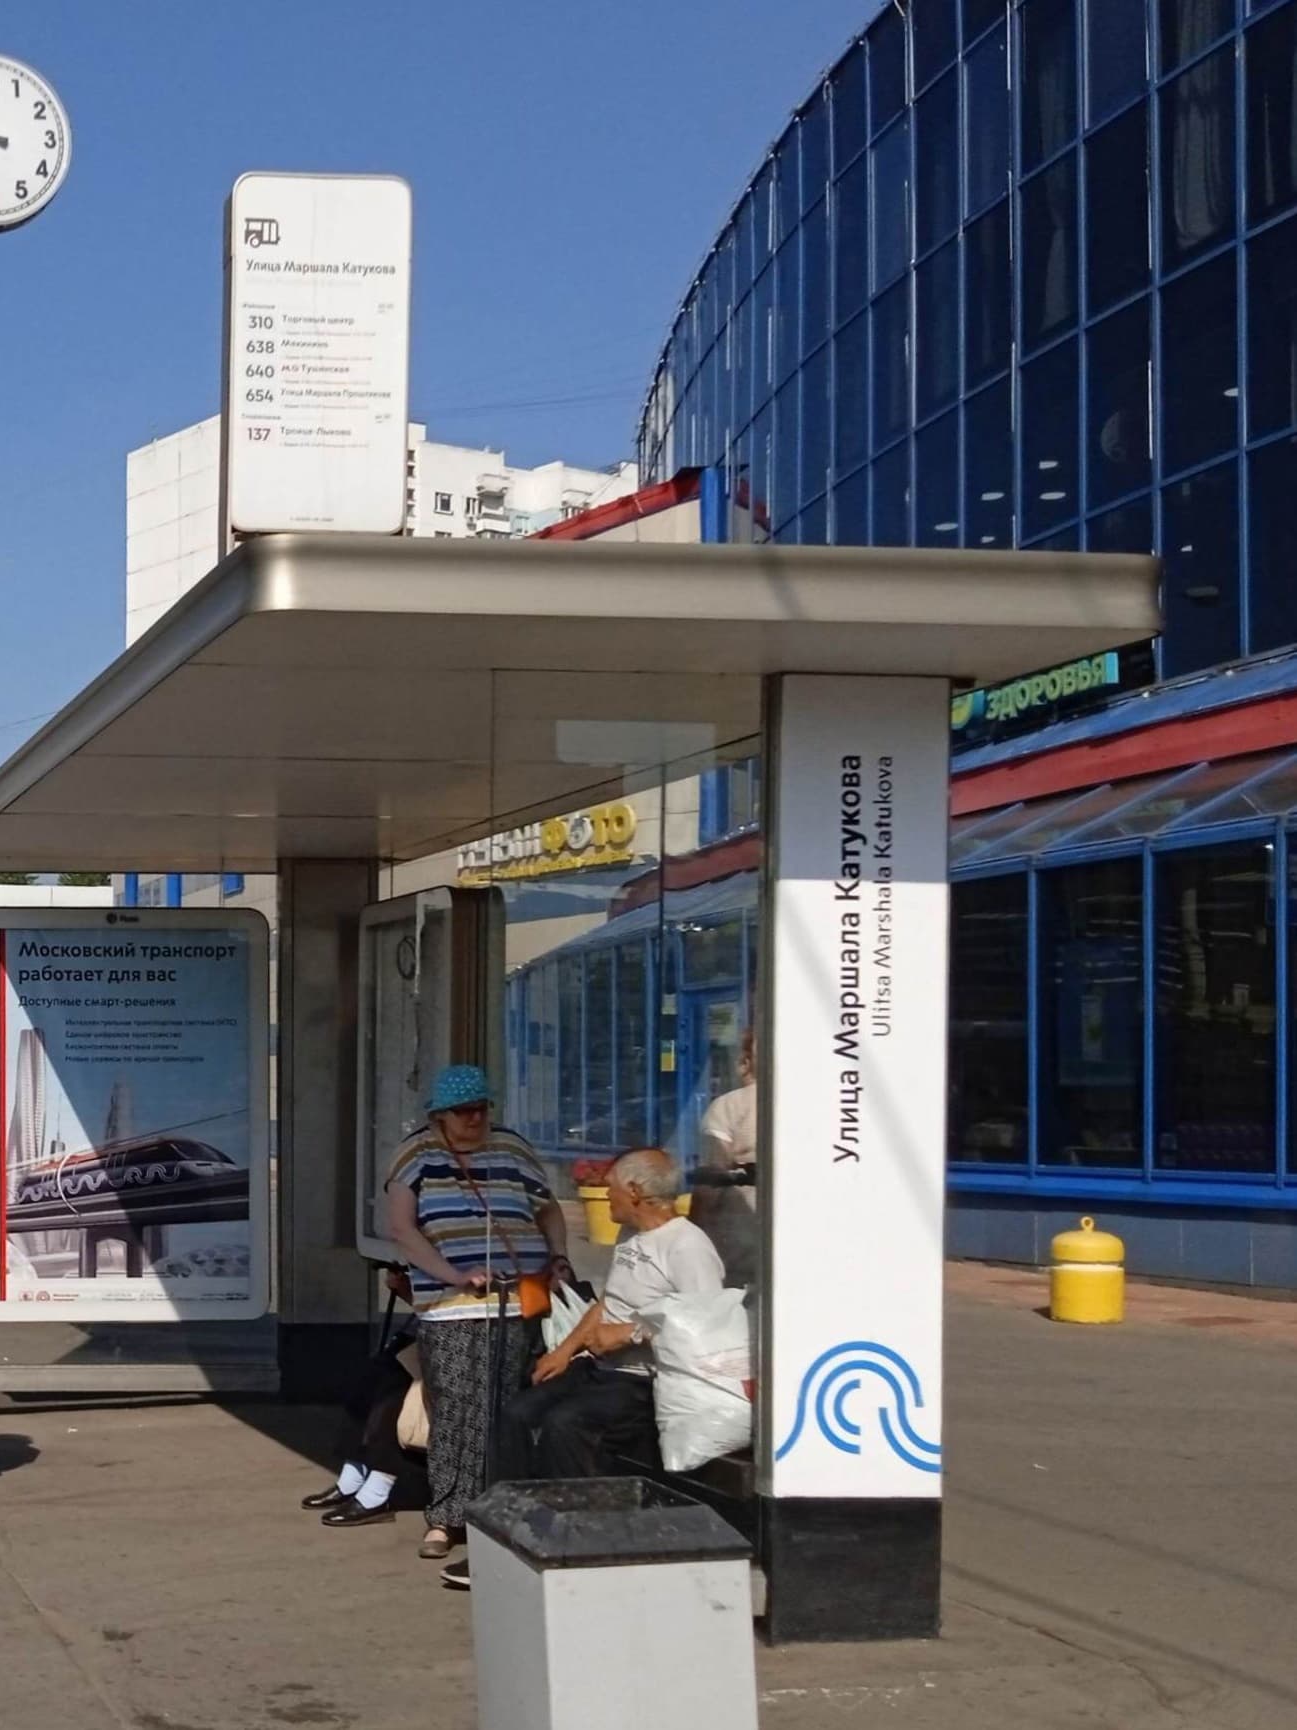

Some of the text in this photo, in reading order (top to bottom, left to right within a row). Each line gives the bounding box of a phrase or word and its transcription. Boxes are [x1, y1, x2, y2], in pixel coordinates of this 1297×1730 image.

[12, 79, 20, 98] 1
[33, 101, 46, 120] 2
[44, 130, 56, 149] 3
[36, 159, 48, 178] 4
[15, 180, 28, 199] 5
[246, 259, 396, 277] Улица Маршала Катукова
[248, 316, 274, 329] 310
[246, 340, 275, 354] 638
[245, 365, 275, 378] 640
[245, 389, 274, 403] 654
[247, 427, 271, 441] 137
[986, 654, 1107, 721] ЗДОРОВЬЯ
[872, 756, 893, 1037] Ulitsa Marshala Katukova
[18, 942, 236, 960] Московский транспорт
[833, 755, 867, 1163] Улица Маршала Катукова
[18, 967, 177, 984] работает для вас
[18, 996, 176, 1008] Доступные смарт-решения
